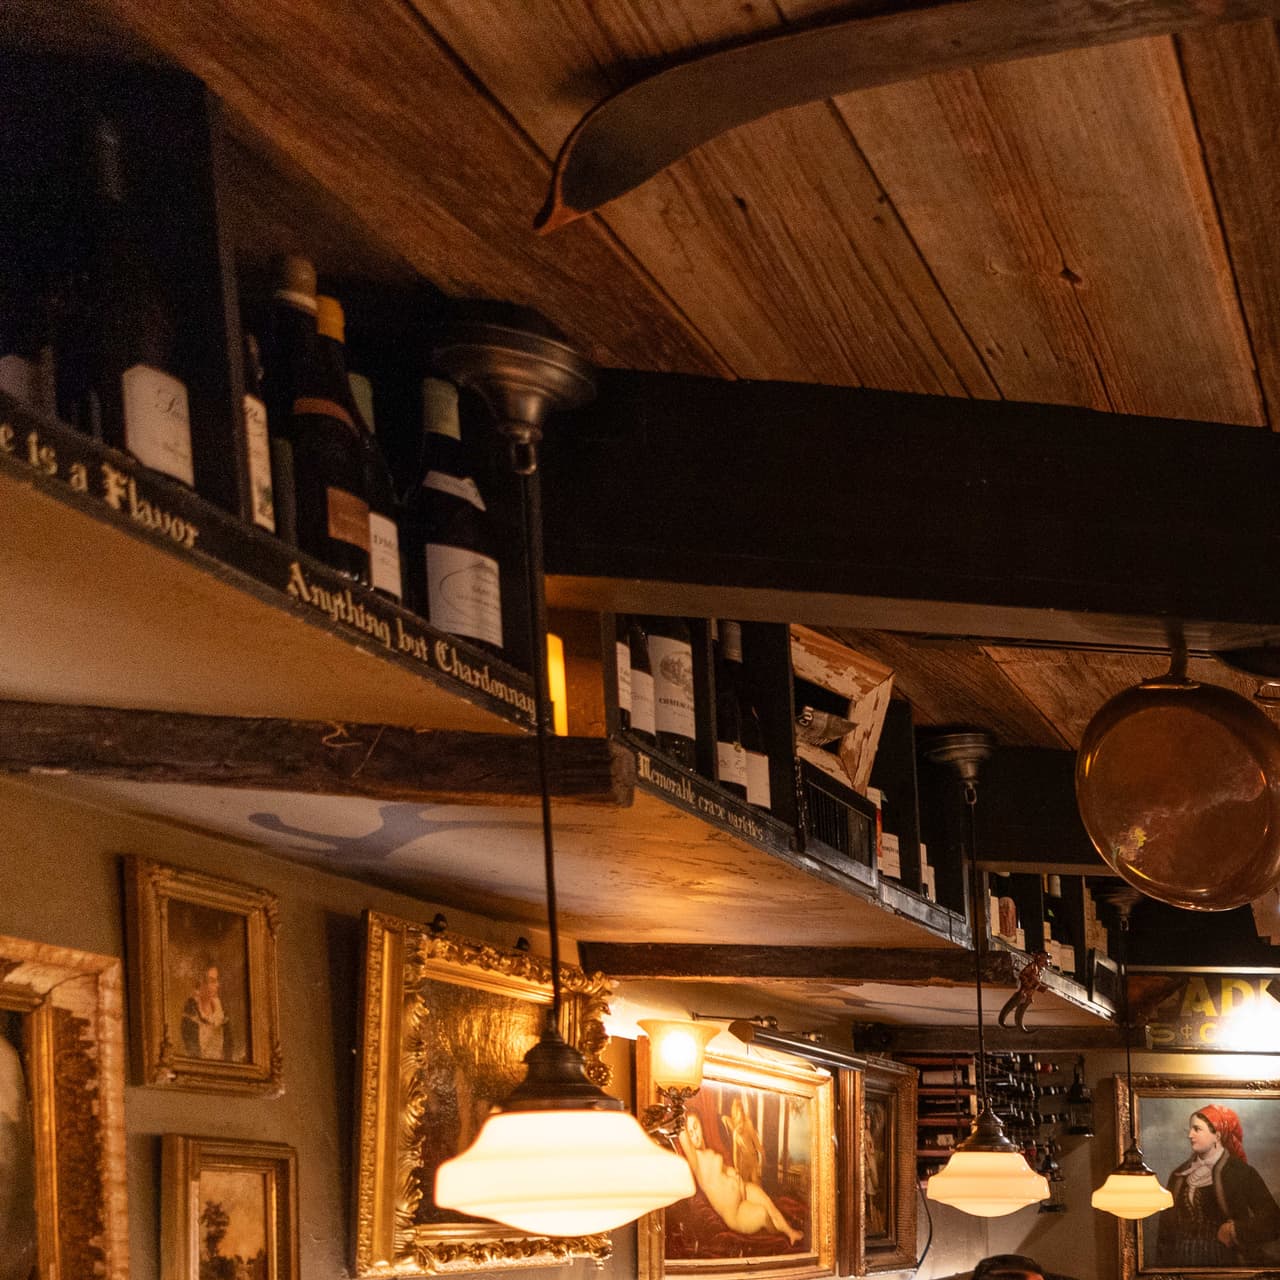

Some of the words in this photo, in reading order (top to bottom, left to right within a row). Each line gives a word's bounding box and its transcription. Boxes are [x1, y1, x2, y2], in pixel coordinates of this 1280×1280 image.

[70, 463, 88, 492] a
[101, 463, 199, 549] Flavor
[287, 560, 391, 648] Anything
[398, 618, 429, 662] but
[435, 640, 537, 720] Chardonnay
[638, 751, 696, 805] Memorable
